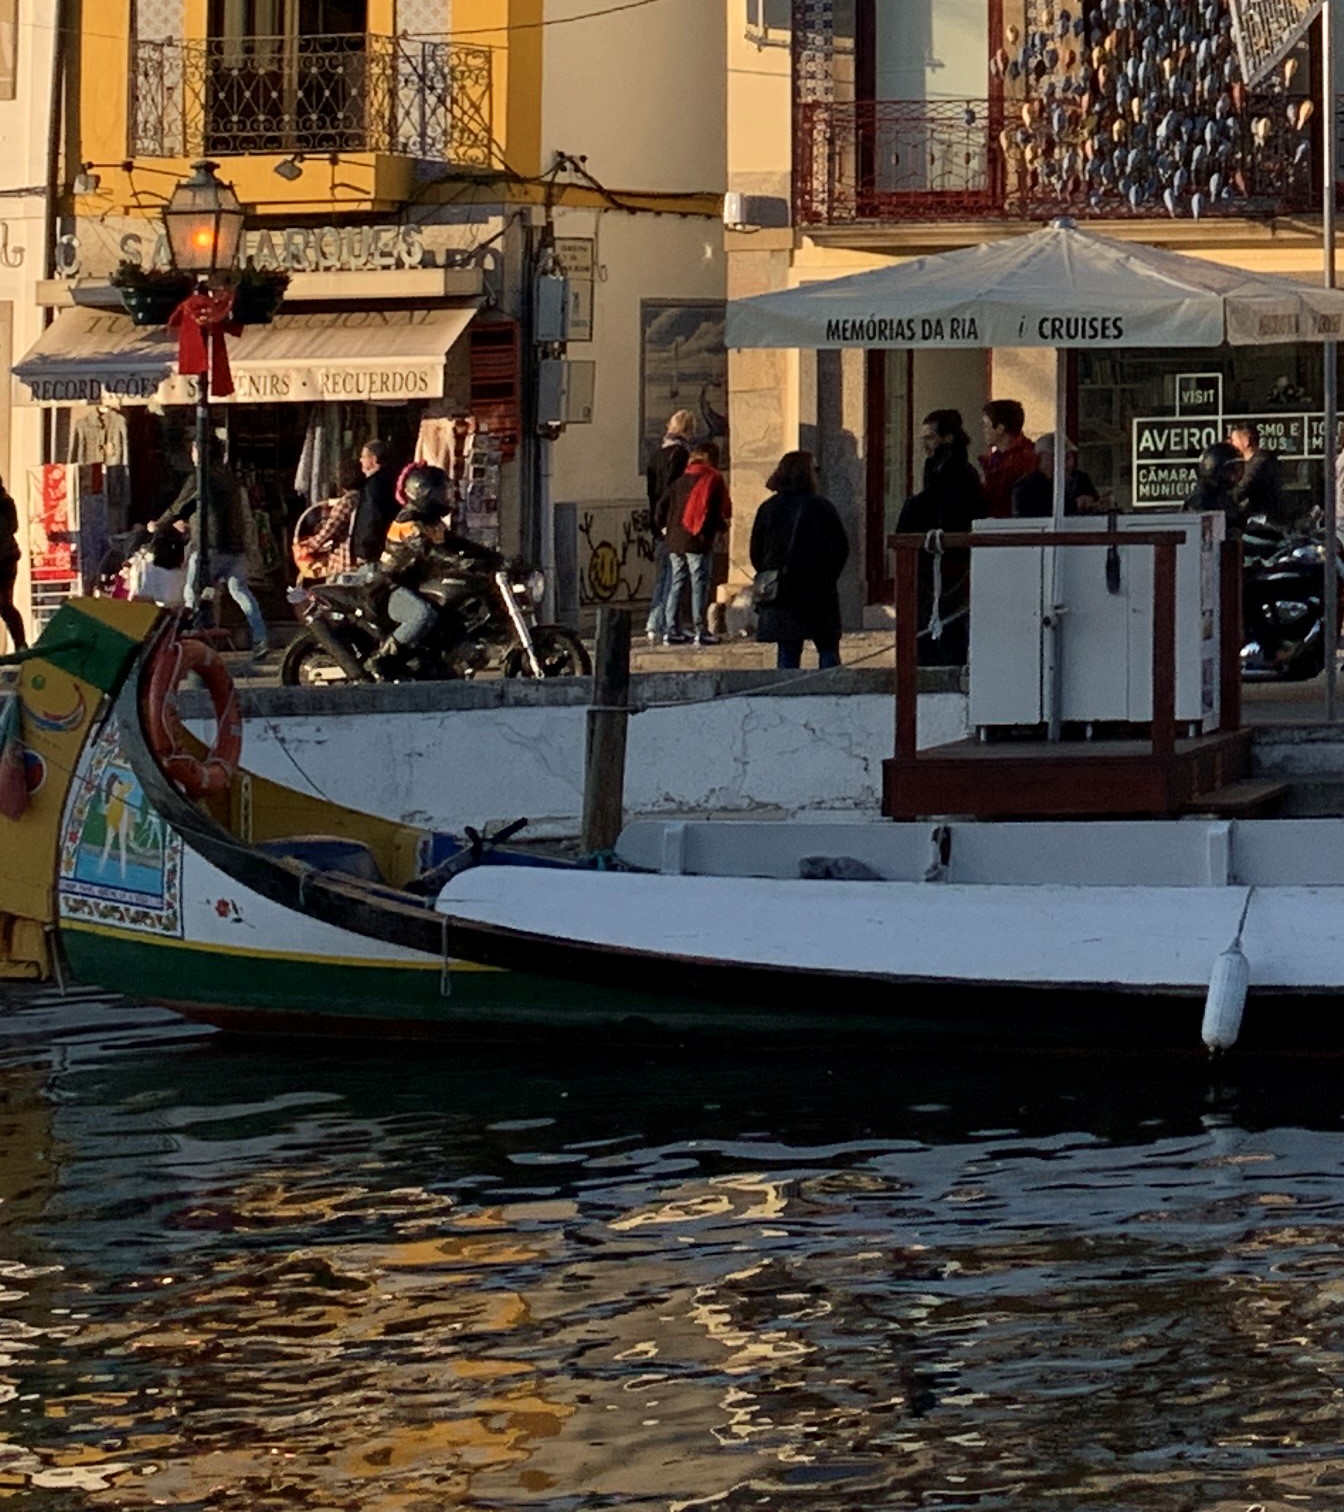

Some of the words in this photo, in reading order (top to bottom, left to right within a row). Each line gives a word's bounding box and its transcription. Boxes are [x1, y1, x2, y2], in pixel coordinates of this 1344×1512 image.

[826, 313, 916, 341] MEMÓRIAS
[921, 318, 944, 340] DA
[950, 317, 978, 340] RIA
[1038, 316, 1124, 340] CRUISES
[320, 370, 428, 395] RECUERDOS
[1181, 389, 1215, 404] VISIT
[1139, 428, 1216, 451] AVEIRO
